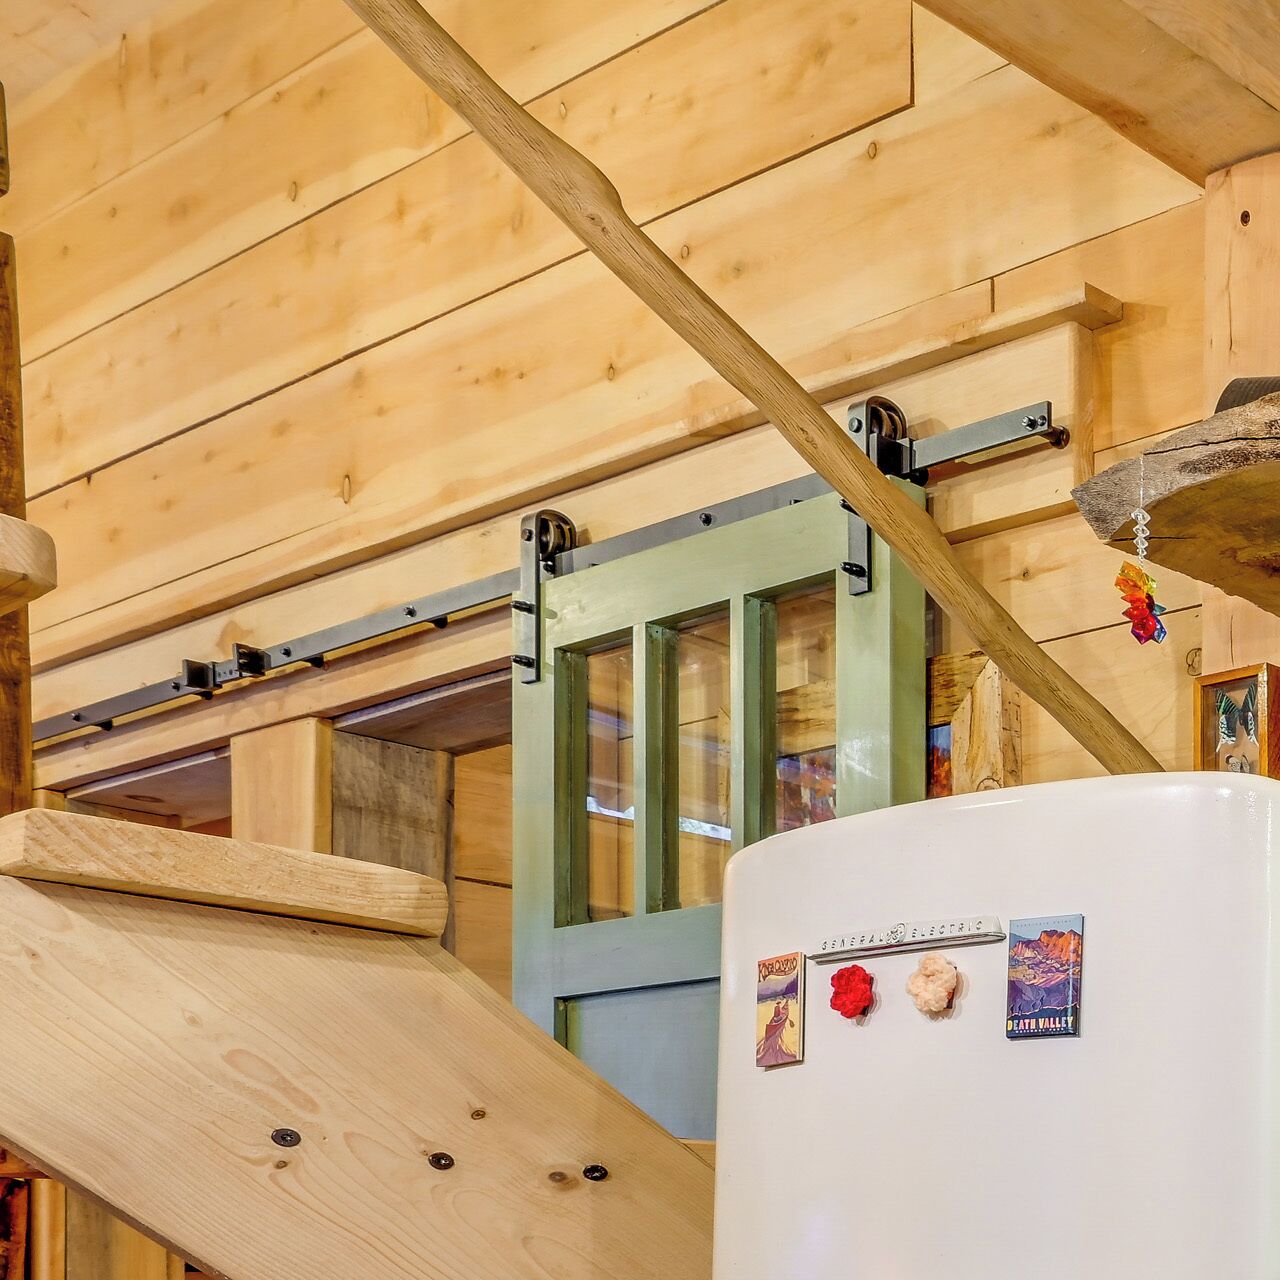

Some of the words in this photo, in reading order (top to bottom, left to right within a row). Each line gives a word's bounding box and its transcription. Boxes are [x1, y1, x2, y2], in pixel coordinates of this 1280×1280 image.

[821, 934, 885, 951] GENERAL
[911, 920, 983, 939] ELECTRIC
[1007, 1018, 1037, 1031] DEATH
[1038, 1015, 1074, 1030] VALLEY
